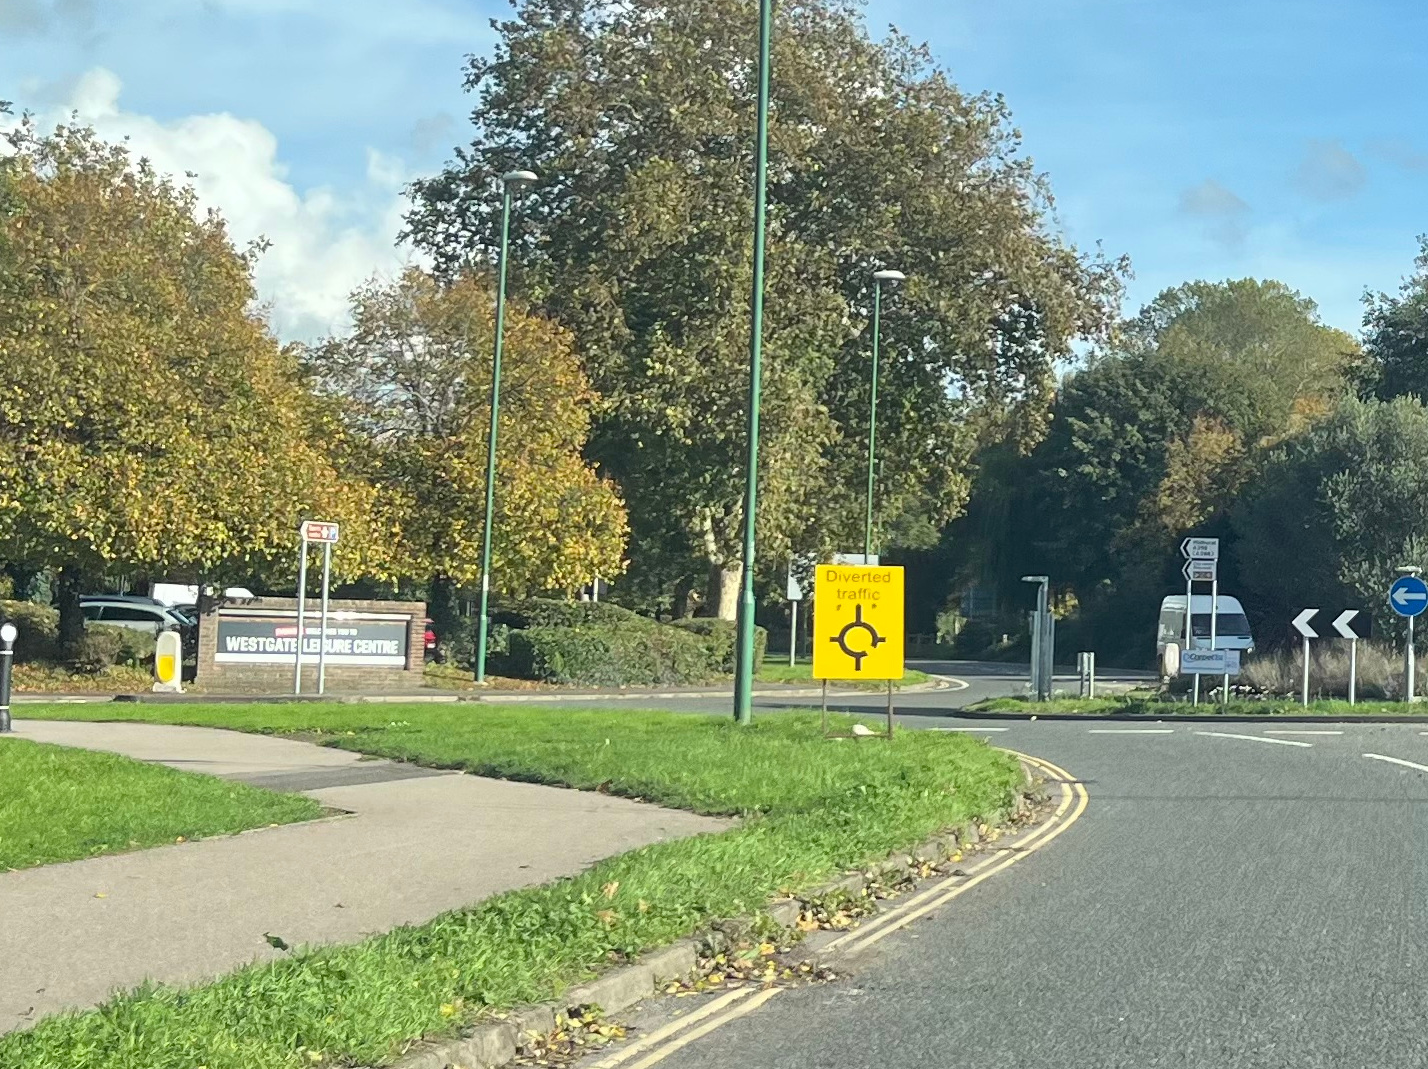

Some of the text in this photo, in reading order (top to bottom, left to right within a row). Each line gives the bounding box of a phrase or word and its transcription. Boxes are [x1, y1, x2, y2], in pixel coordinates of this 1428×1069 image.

[826, 570, 891, 583] Diverted
[836, 587, 880, 600] traffic
[226, 636, 399, 654] WESTGATE LEISURE CENTRE
